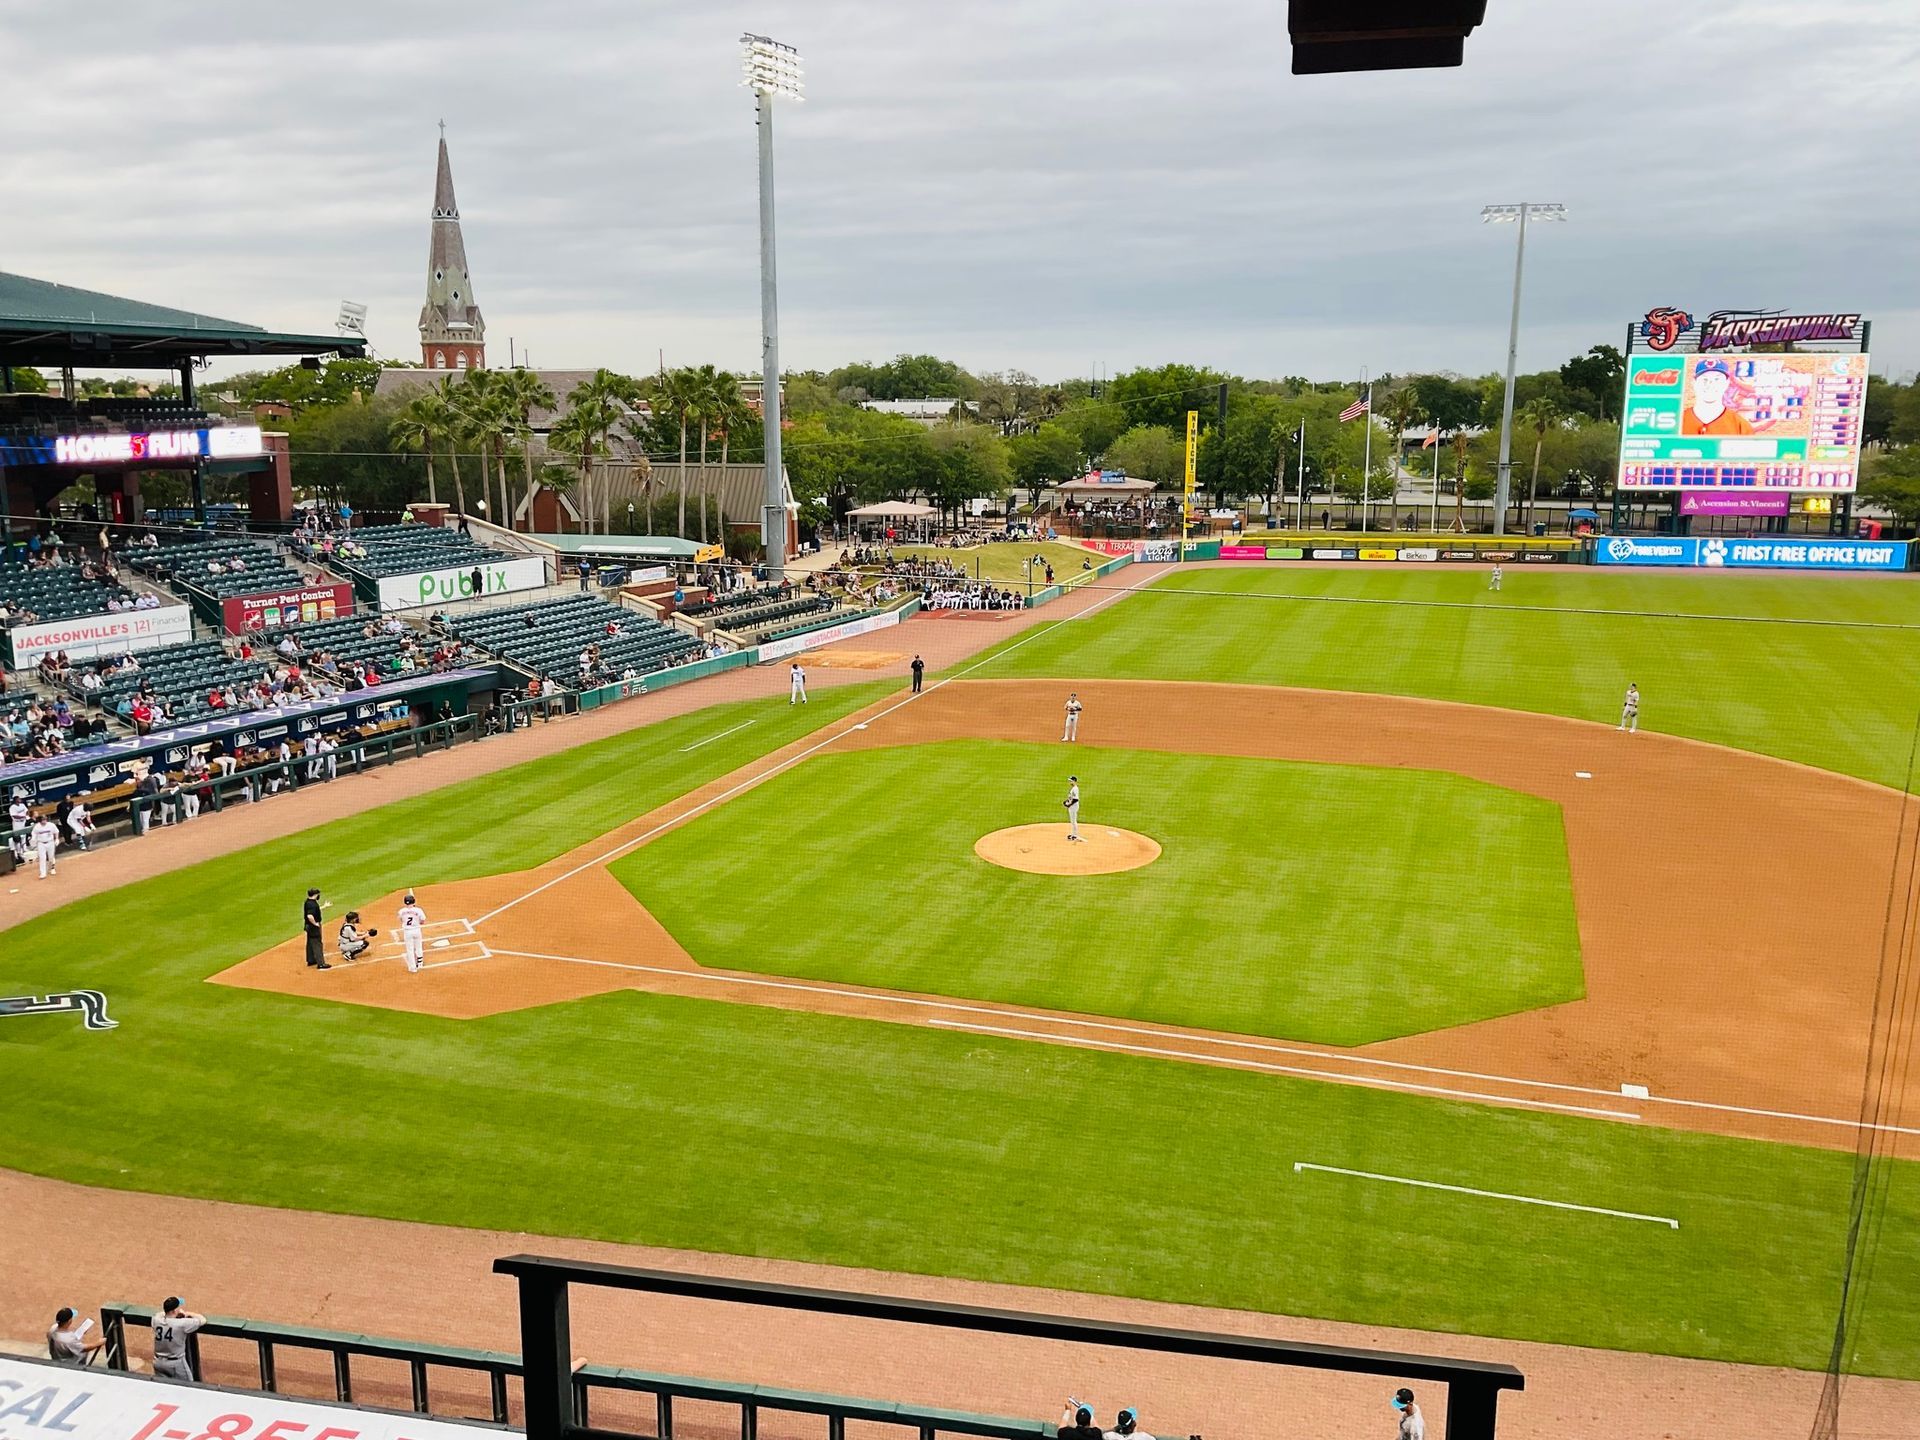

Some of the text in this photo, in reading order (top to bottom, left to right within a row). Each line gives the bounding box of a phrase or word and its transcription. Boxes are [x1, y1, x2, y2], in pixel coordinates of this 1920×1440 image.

[1702, 314, 1861, 349] JACKSONVILLE
[56, 436, 132, 461] HOME
[148, 433, 199, 456] RUN
[1700, 500, 1785, 508] Ascension St. Vincent's
[1111, 542, 1139, 551] TERRACE
[1145, 546, 1174, 555] Coors
[1184, 543, 1197, 551] 321
[1732, 545, 1893, 564] FIRST FREE OFFICE VISIT
[419, 565, 507, 604] Pubix
[243, 589, 334, 608] Turner Pest Control
[16, 623, 129, 649] JACKSONVILLE'S
[151, 613, 187, 626] Financial
[406, 917, 413, 926] 2
[155, 1326, 174, 1342] 34
[128, 1404, 361, 1440] 1-8
